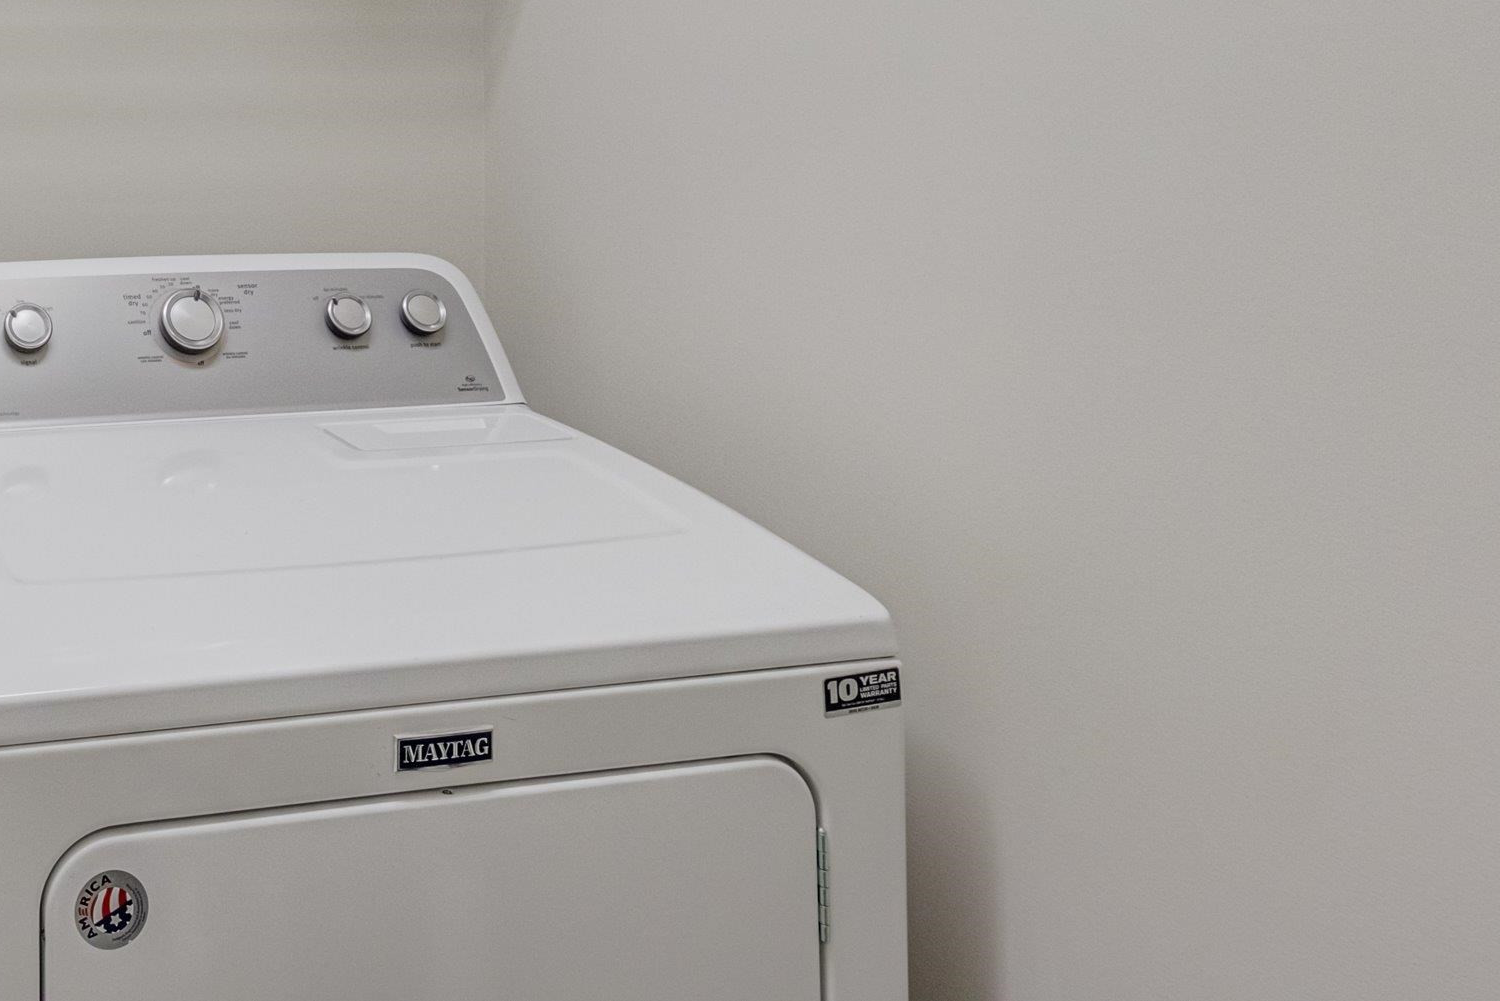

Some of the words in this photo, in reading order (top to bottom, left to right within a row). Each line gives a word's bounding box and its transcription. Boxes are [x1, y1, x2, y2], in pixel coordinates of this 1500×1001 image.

[827, 678, 859, 704] 10
[860, 671, 897, 685] YEAR
[860, 687, 898, 699] WARRANTY
[403, 737, 490, 763] MAYTAG
[78, 874, 112, 939] AMERICA
